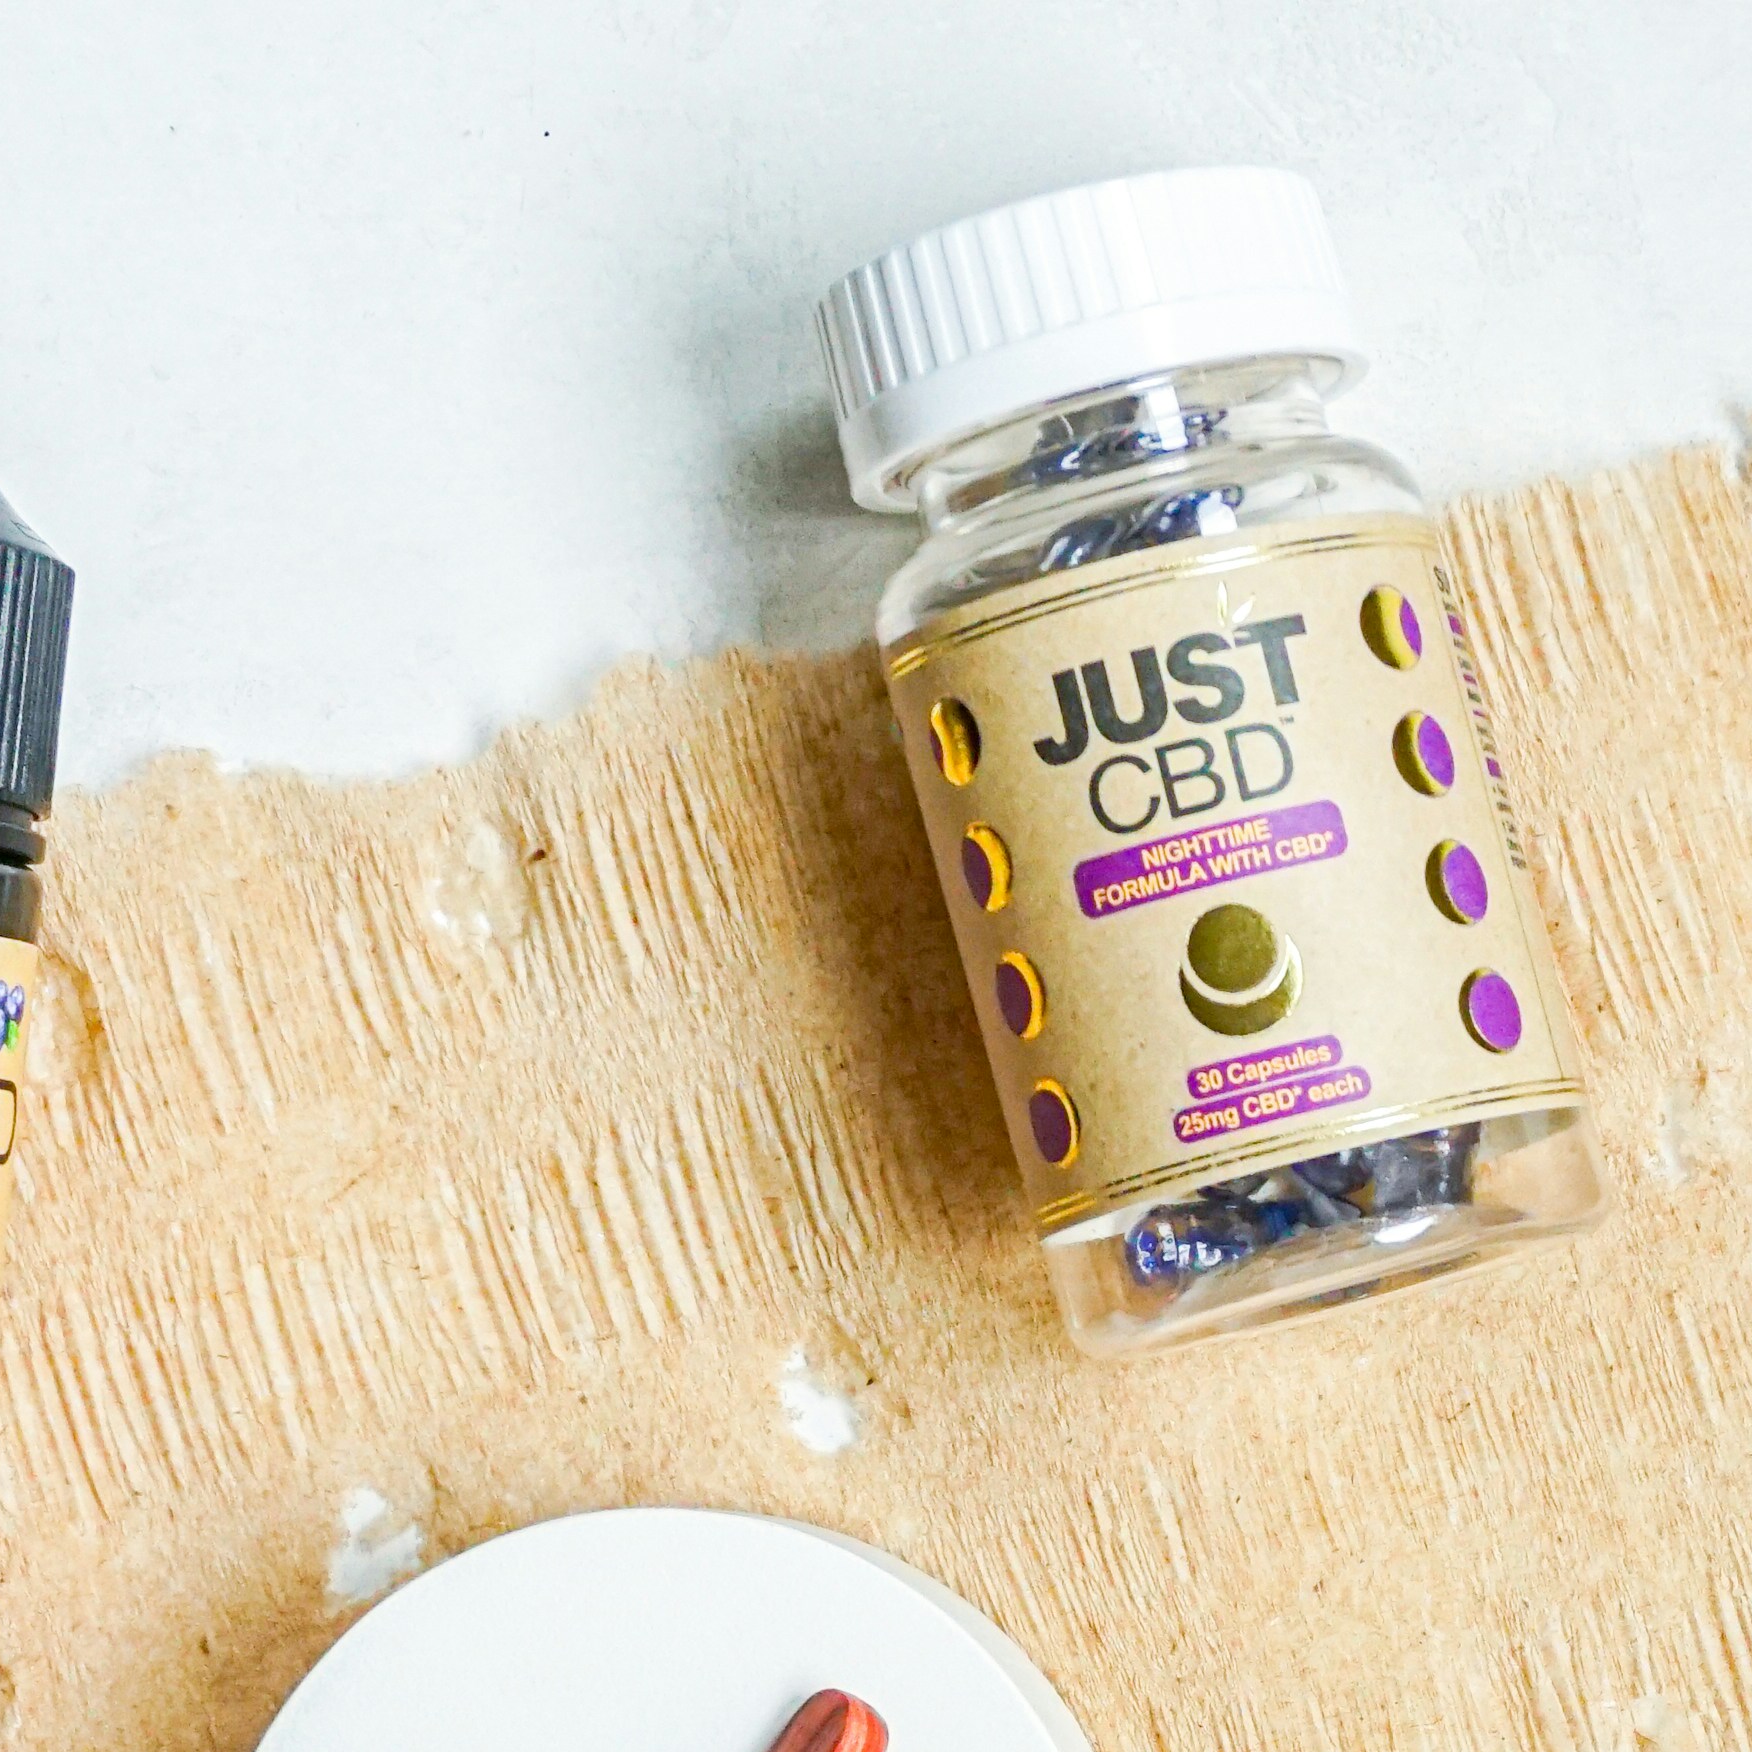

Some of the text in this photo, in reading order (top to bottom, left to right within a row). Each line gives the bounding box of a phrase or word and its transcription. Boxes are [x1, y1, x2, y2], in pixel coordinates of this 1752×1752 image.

[1033, 613, 1308, 767] JUST
[1140, 817, 1273, 871] NIGHTTIME
[1092, 863, 1208, 910] FORMULA
[1207, 847, 1272, 878] WITH
[1195, 1044, 1333, 1094] 30 Capsules
[1178, 1105, 1242, 1137] 25mg
[1308, 1073, 1364, 1103] each
